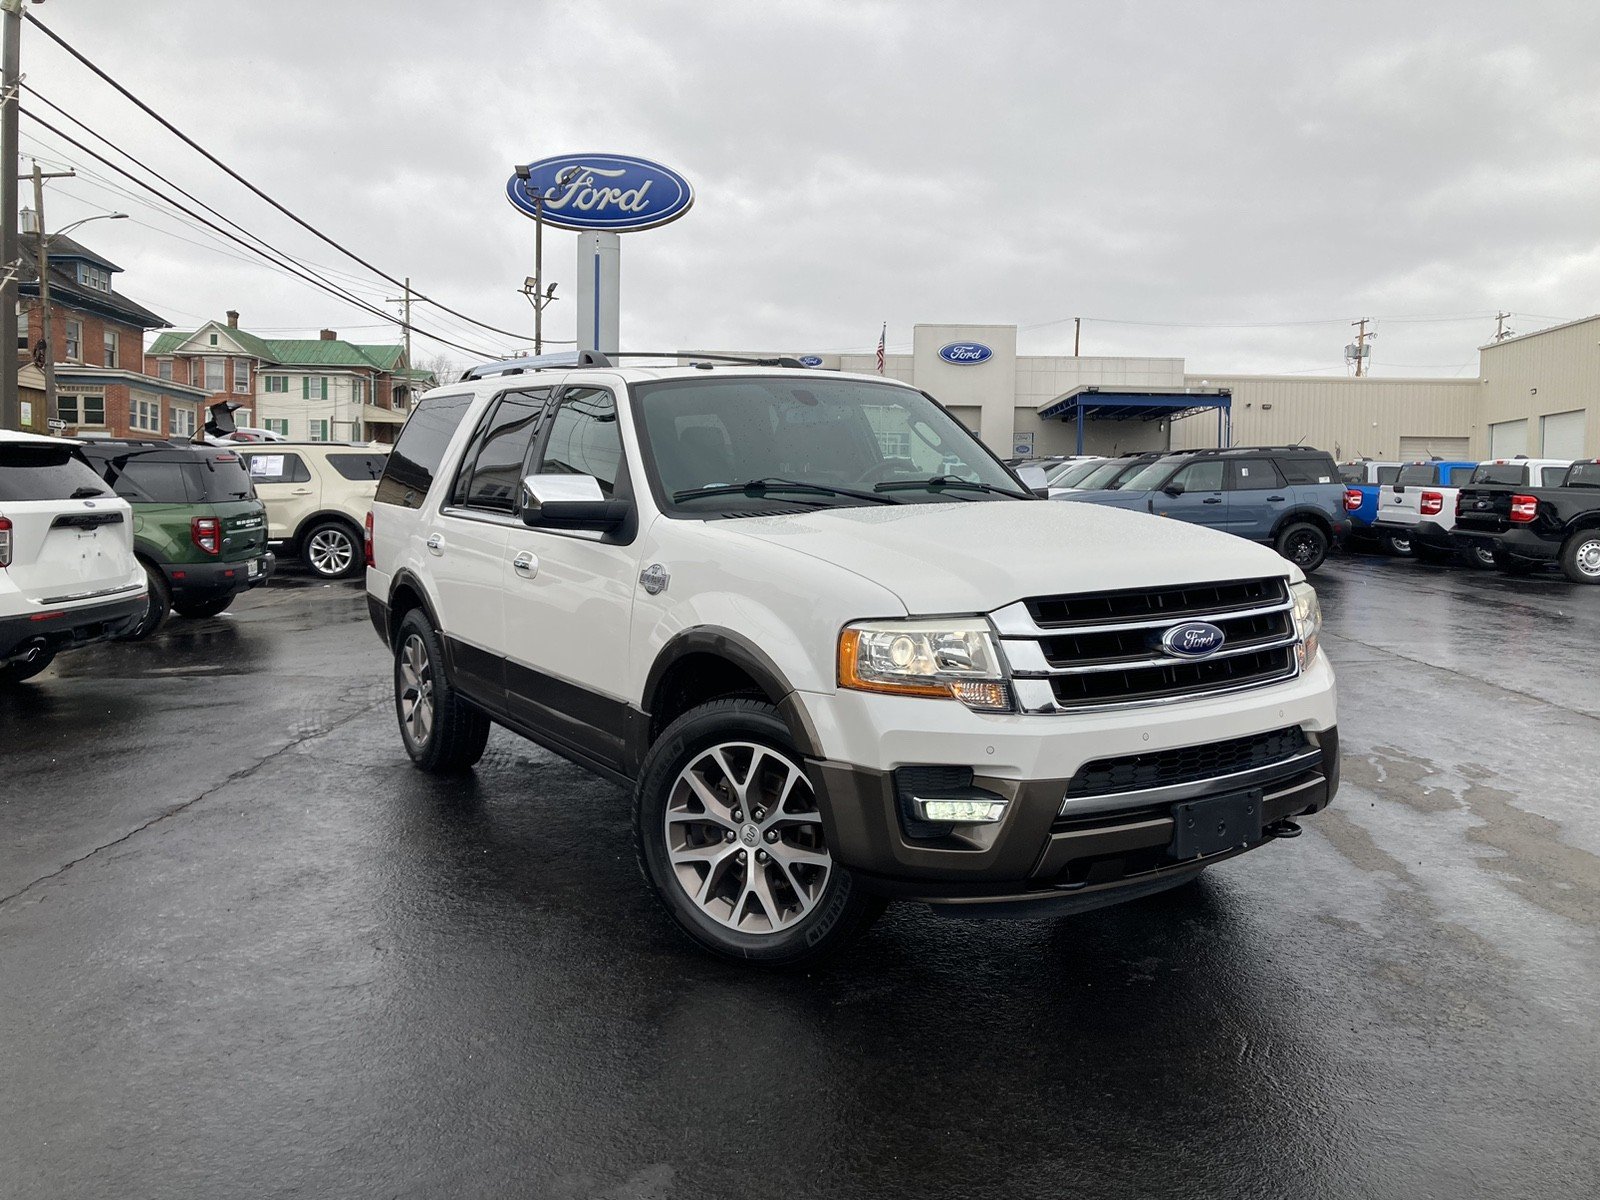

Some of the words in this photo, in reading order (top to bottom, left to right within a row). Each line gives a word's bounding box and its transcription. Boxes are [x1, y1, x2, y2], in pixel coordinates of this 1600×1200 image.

[544, 165, 652, 212] Ford
[950, 346, 981, 359] Ford
[1183, 629, 1215, 649] Ford
